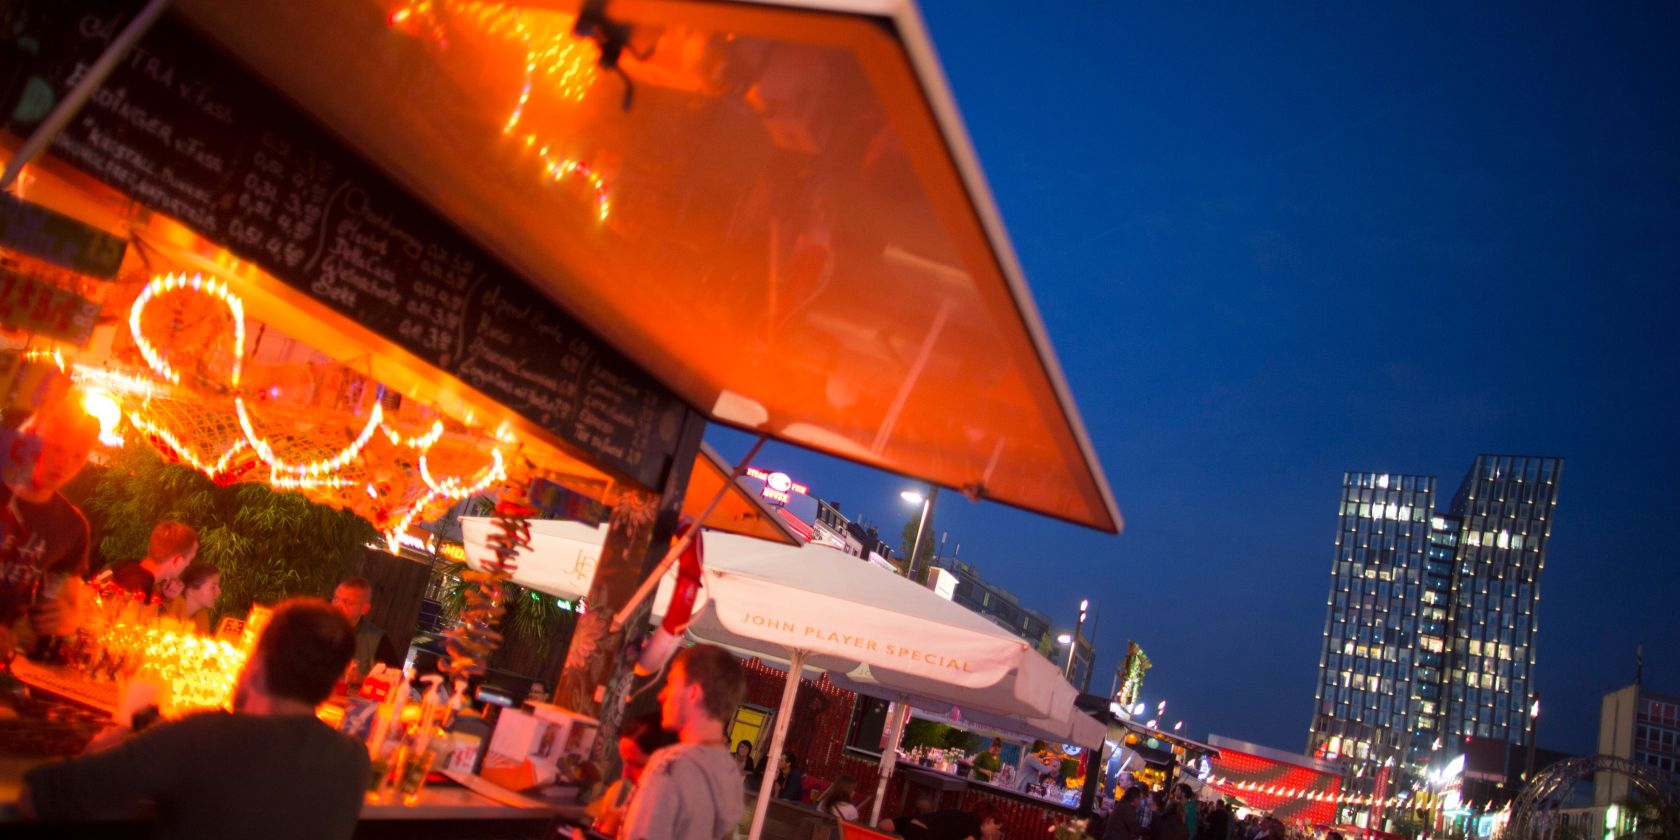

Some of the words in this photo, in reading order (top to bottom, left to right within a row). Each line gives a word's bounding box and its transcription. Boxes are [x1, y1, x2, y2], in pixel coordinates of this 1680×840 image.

[740, 613, 796, 635] JOHN
[804, 625, 879, 651] PLAYER
[886, 644, 974, 673] SPECIAL
